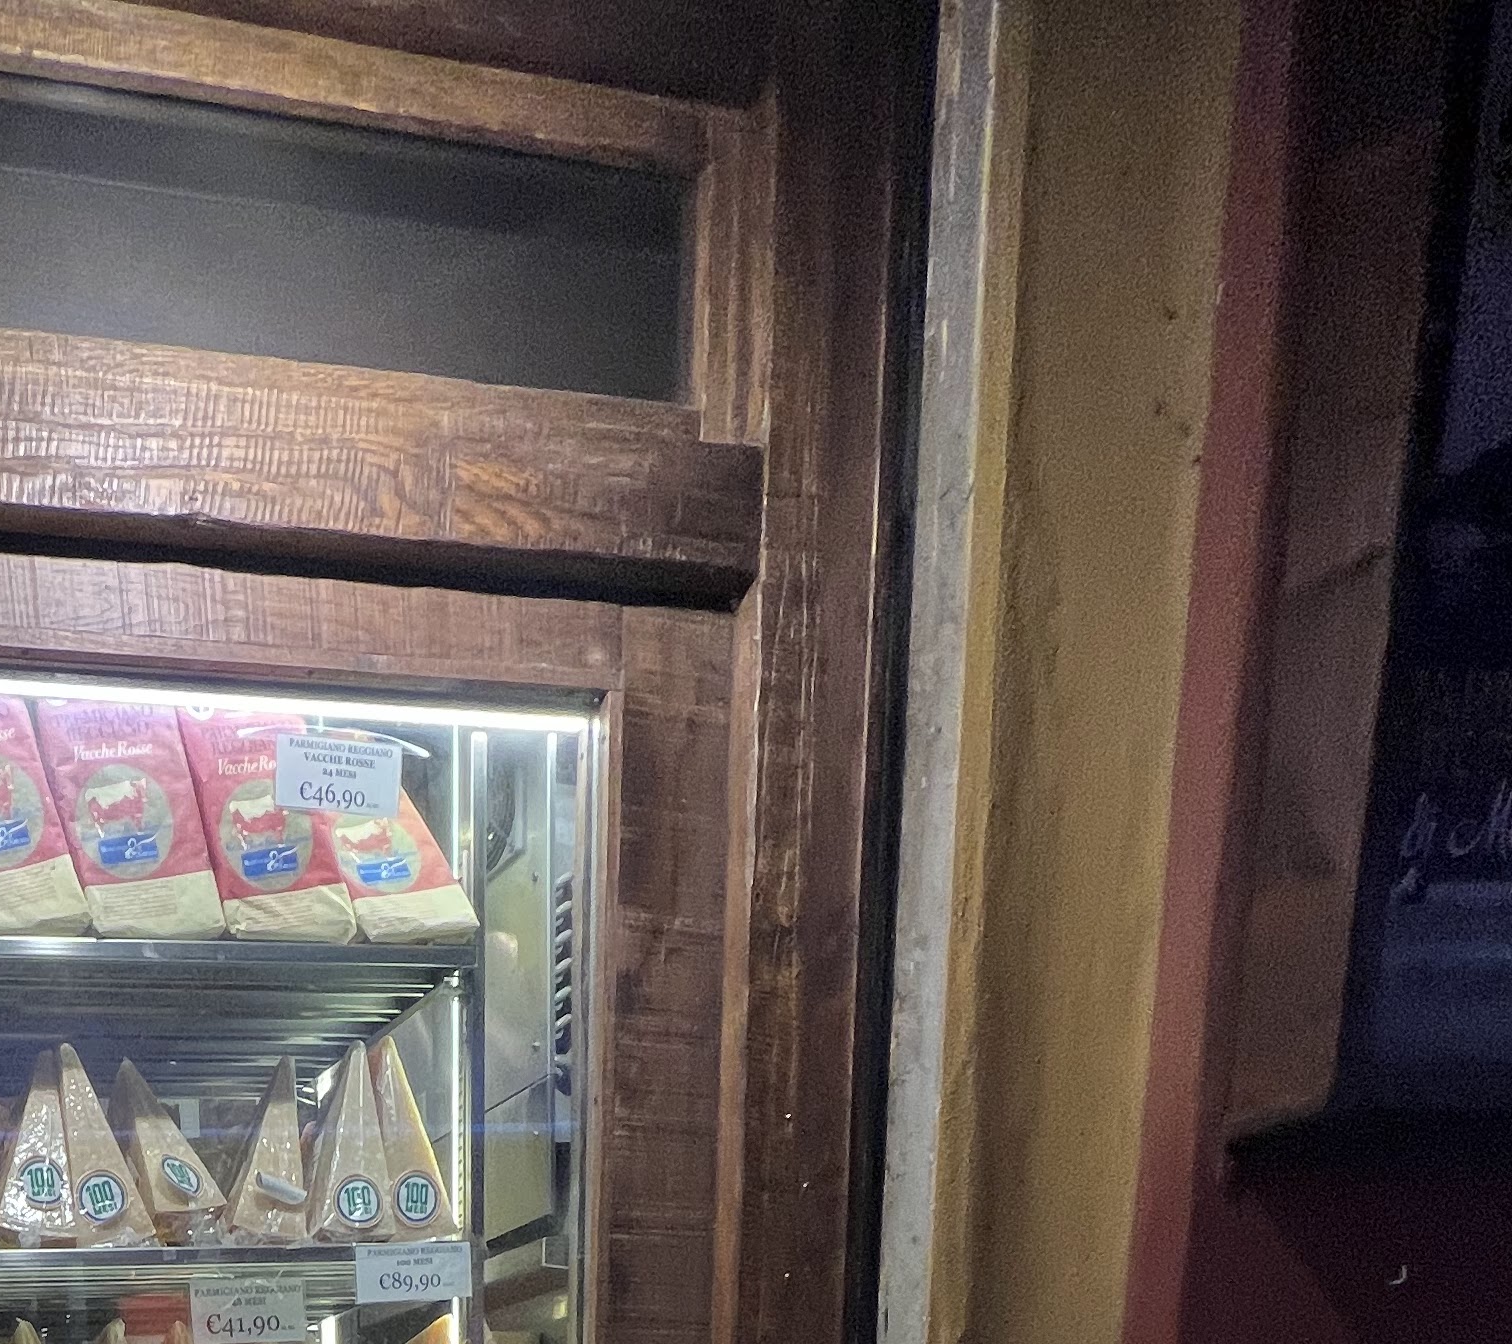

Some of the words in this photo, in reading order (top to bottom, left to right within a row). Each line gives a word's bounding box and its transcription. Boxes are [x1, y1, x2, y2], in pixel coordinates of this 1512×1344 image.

[73, 745, 117, 763] Vacche
[117, 741, 153, 758] Rosse
[290, 738, 346, 753] PARMIGIANO
[347, 743, 394, 758] REGGIANO
[218, 758, 258, 776] Vacche
[304, 752, 344, 765] VACCHE
[345, 756, 376, 769] ROSSE
[335, 768, 357, 779] MESI
[299, 781, 366, 809] €46,90
[27, 1167, 56, 1189] 100
[87, 1180, 113, 1204] 100
[404, 1181, 429, 1204] 100
[367, 1247, 419, 1257] PARMIGIANO
[420, 1246, 463, 1256] REGGIANO
[379, 1272, 441, 1292] €89,90
[206, 1313, 280, 1338] €41,90
